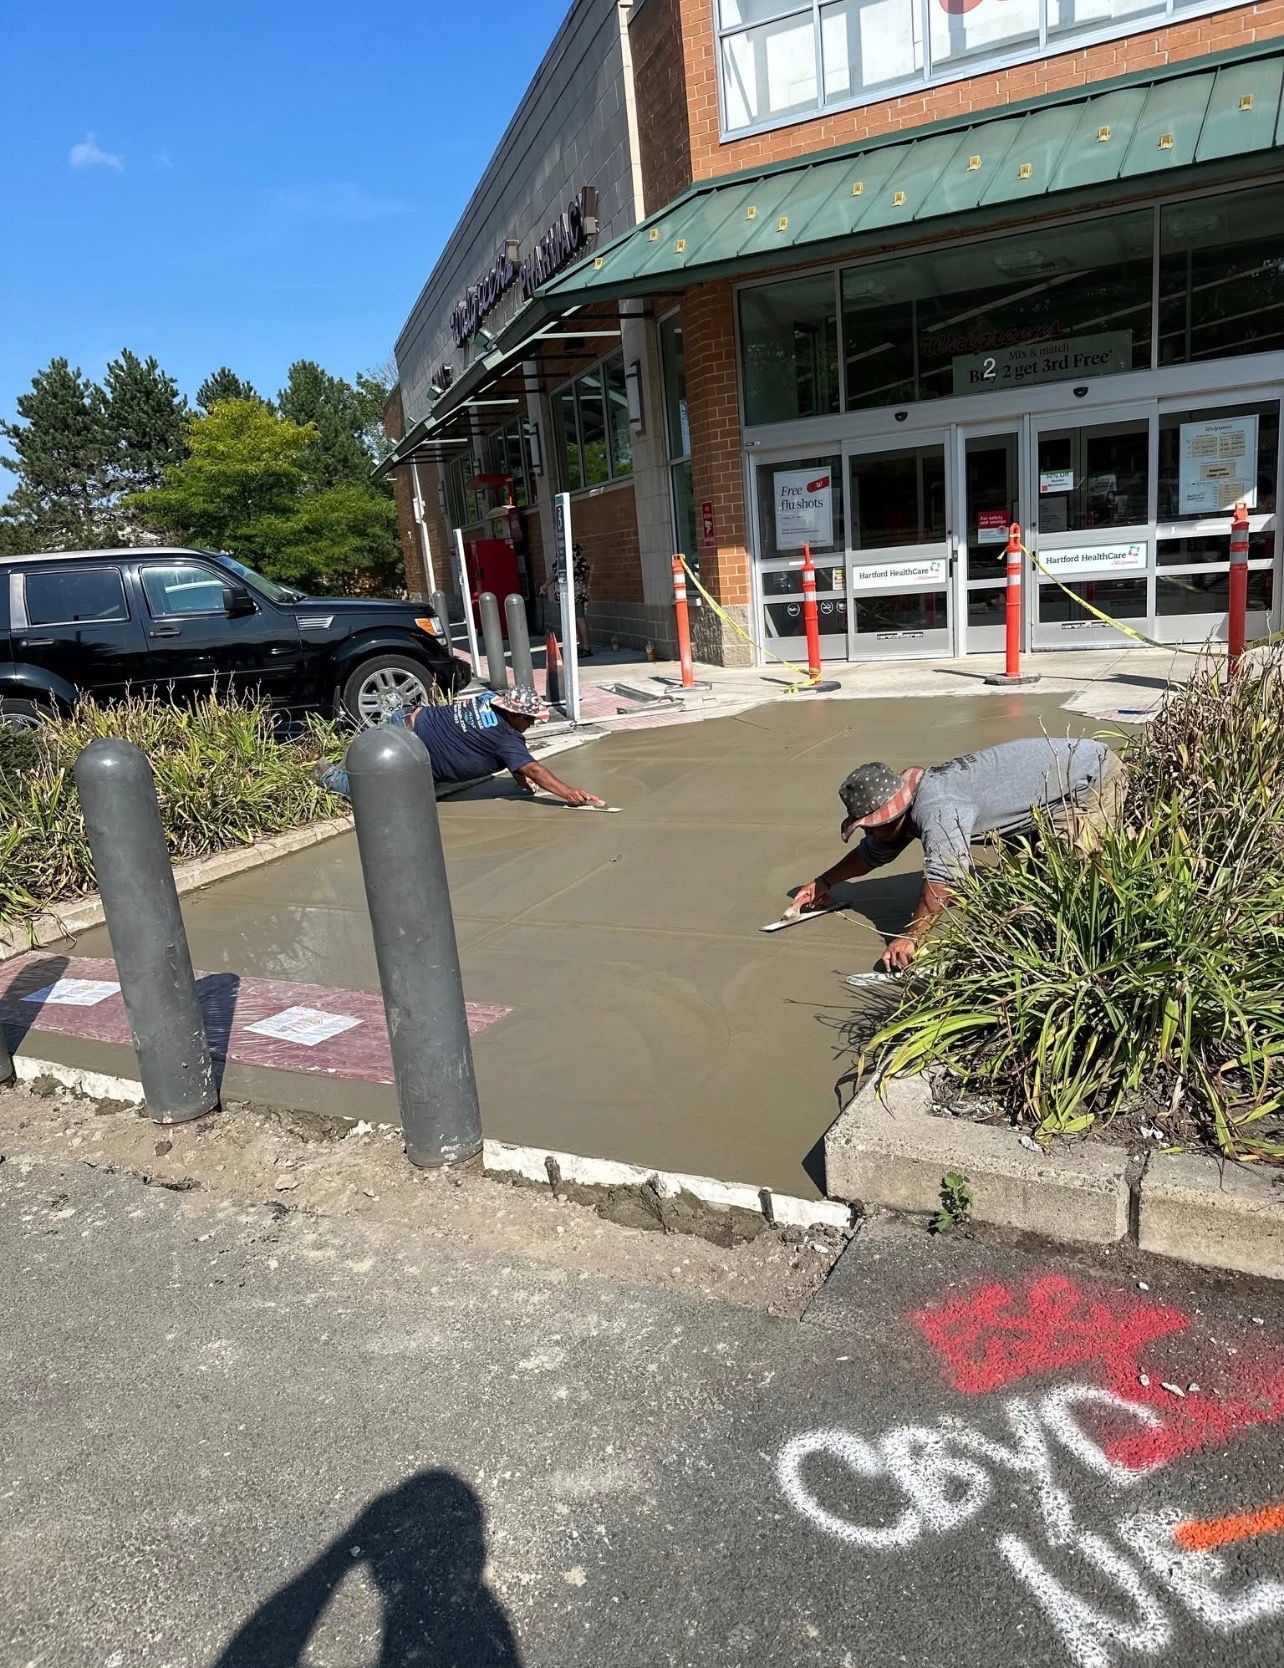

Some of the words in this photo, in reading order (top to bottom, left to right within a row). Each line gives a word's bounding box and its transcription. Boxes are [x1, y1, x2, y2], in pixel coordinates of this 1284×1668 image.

[1009, 350, 1026, 360] Mix
[1029, 349, 1037, 358] &
[1040, 342, 1070, 356] match
[983, 357, 996, 378] 2
[1002, 365, 1012, 378] 2
[1015, 361, 1038, 380] get
[1042, 355, 1069, 373] 3rd
[781, 486, 803, 497] Free
[781, 499, 795, 511] flu
[796, 498, 824, 509] shots
[1046, 554, 1079, 564] Hartford
[1081, 552, 1127, 562] HealthCare
[859, 569, 888, 580] Hartford
[890, 568, 929, 577] HealthCare
